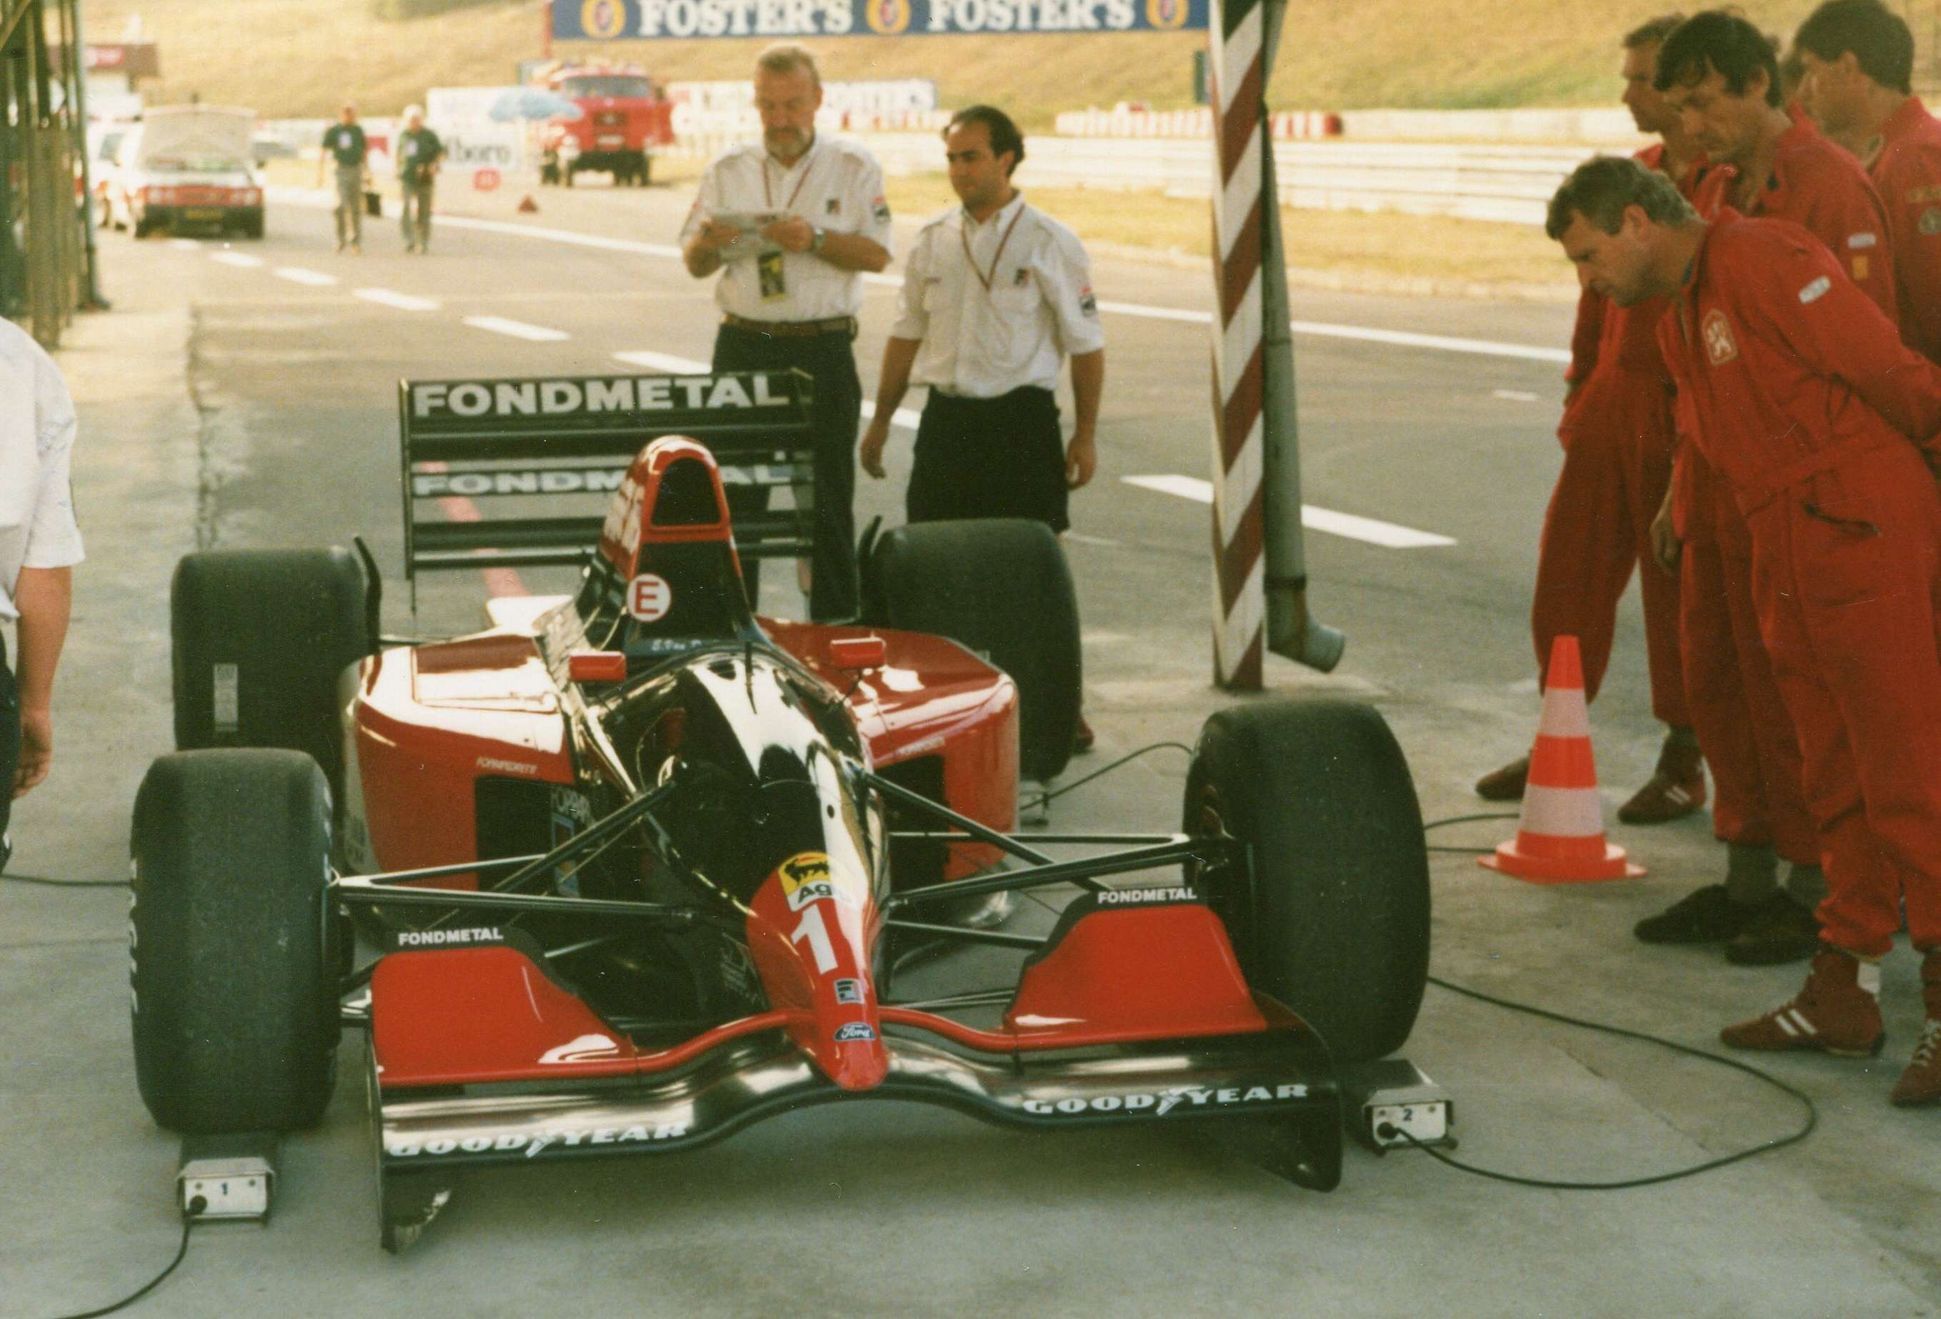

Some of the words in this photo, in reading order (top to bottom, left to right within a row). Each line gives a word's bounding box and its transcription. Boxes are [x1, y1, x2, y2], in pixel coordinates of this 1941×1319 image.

[637, 0, 854, 36] FOSTER'S
[413, 374, 790, 417] FONDMETAL
[413, 464, 794, 496] FONDMAL
[634, 580, 660, 615] E
[1097, 887, 1198, 905] FONDMETAL
[397, 927, 504, 946] FONDMETAL
[790, 903, 839, 976] 1
[840, 1025, 872, 1040] Ford
[1022, 1084, 1309, 1116] GOODYEAR
[1403, 1108, 1413, 1122] 2
[389, 1121, 688, 1159] GOODYEAR
[221, 1182, 228, 1196] 1
